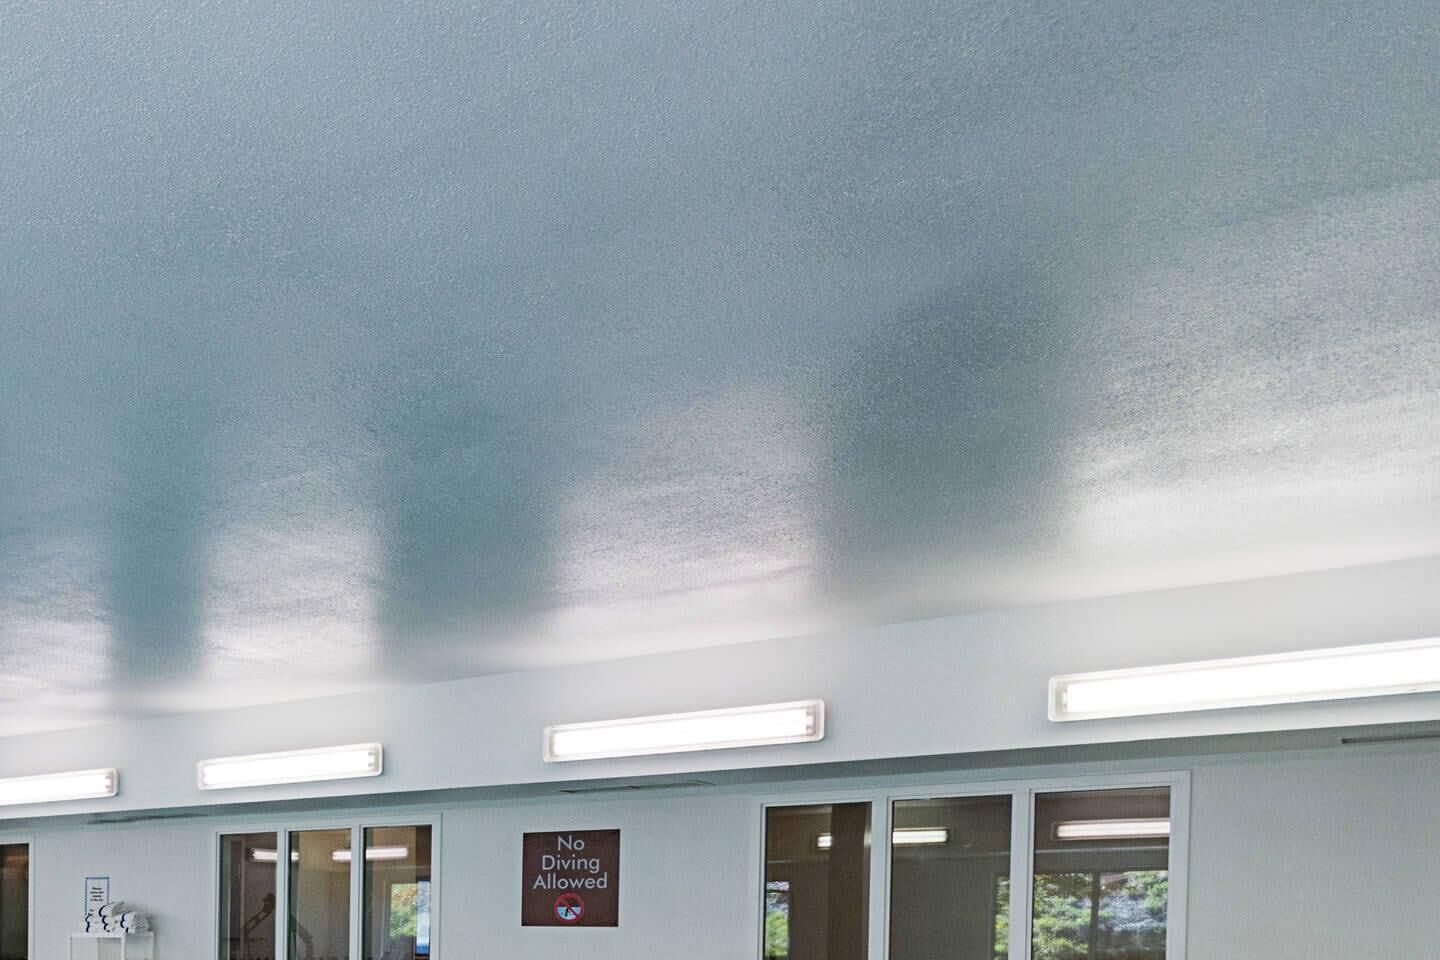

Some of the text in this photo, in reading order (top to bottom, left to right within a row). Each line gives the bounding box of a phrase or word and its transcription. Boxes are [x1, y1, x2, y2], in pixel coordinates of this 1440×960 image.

[557, 835, 585, 851] No
[542, 854, 600, 874] Diving
[533, 872, 608, 890] Allowed
